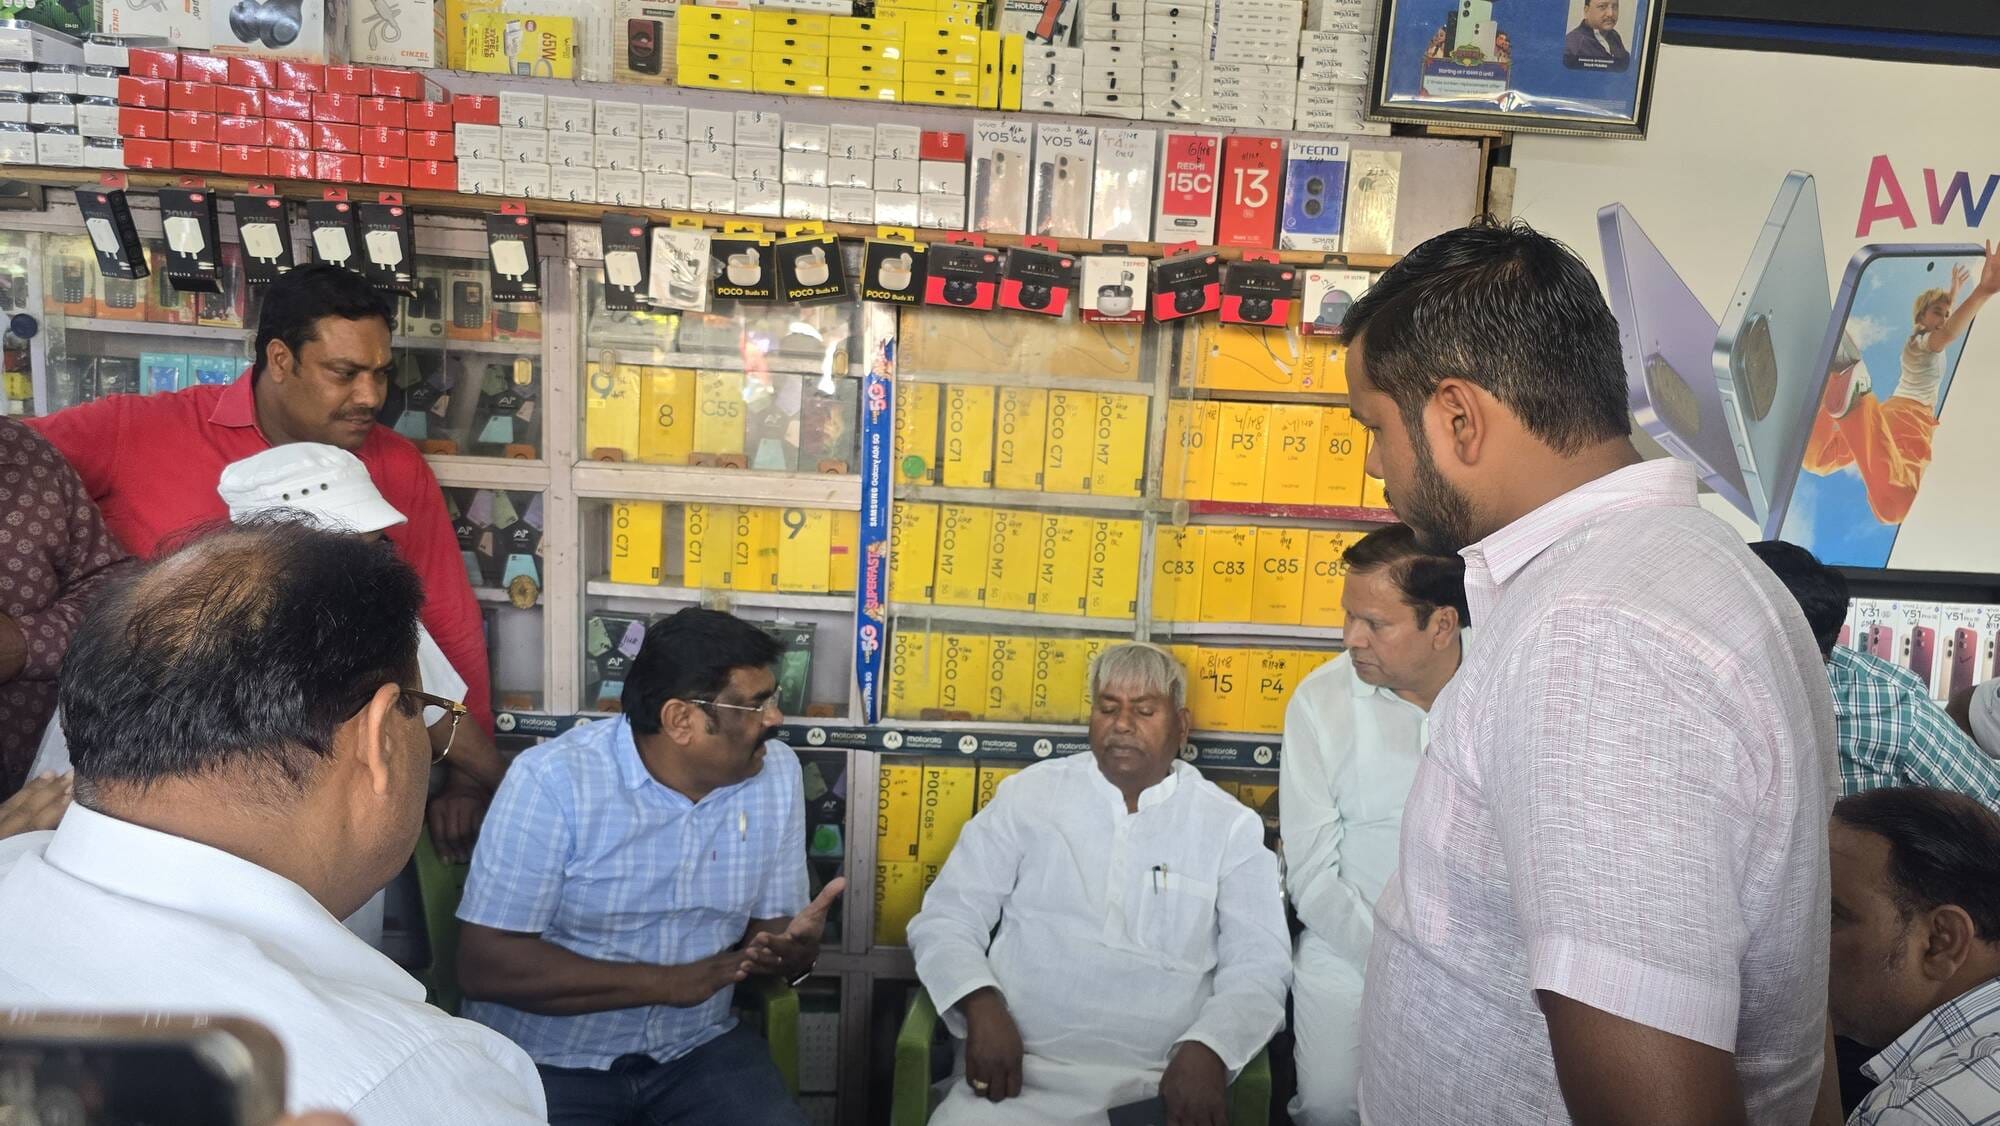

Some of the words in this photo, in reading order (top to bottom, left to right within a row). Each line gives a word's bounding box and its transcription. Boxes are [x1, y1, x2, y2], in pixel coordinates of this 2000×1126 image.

[1014, 3, 1045, 11] HOLDER
[400, 50, 430, 58] CINZEL
[542, 32, 557, 61] 65W
[1300, 144, 1338, 156] TECNO
[1177, 161, 1205, 170] REDMI
[1168, 173, 1212, 193] 15C
[1233, 168, 1269, 209] 13
[1855, 154, 2000, 238] Aw
[718, 287, 743, 296] POCO
[789, 289, 814, 298] POCO
[866, 290, 891, 300] POCO
[868, 383, 887, 411] 5G
[658, 404, 674, 427] 8
[701, 400, 739, 418] C55
[950, 388, 964, 432] POCO
[1003, 390, 1017, 435] POCO
[1052, 395, 1066, 440] POCO
[1099, 396, 1112, 440] POCO
[949, 438, 962, 463] C71
[1001, 439, 1014, 465] C71
[1231, 433, 1254, 450] P3
[1283, 436, 1306, 452] P3
[1329, 438, 1352, 455] 80
[1050, 444, 1063, 469] C71
[1097, 444, 1109, 465] M7
[871, 459, 881, 486] Galaxy
[869, 488, 878, 527] SAMSUNG
[689, 503, 702, 536] OCO
[736, 505, 749, 537] OCO
[783, 507, 807, 540] 9
[890, 505, 904, 547] POCO
[943, 508, 958, 550] POCO
[992, 512, 1007, 554] POCO
[1043, 518, 1058, 560] POCO
[1094, 521, 1108, 564] POCO
[616, 533, 628, 557] C71
[689, 540, 702, 563] C71
[736, 542, 748, 565] C71
[889, 551, 900, 572] M7
[941, 555, 954, 575] M7
[991, 558, 1004, 579] M7
[1162, 560, 1194, 575] C83
[1213, 561, 1245, 575] C83
[1264, 558, 1298, 574] C85
[1314, 561, 1349, 577] C85
[866, 552, 880, 609] SUPERFAST
[1041, 564, 1054, 584] M7
[1091, 567, 1104, 588] M7
[1860, 608, 1880, 617] Y31
[1903, 609, 1921, 618] Y51
[1945, 612, 1964, 621] Y51
[860, 625, 879, 651] 5G
[894, 634, 908, 676] POCO
[946, 638, 959, 680] POCO
[991, 639, 1006, 682] POCO
[1036, 641, 1050, 680] POCO
[943, 684, 956, 708] C71
[1035, 684, 1047, 708] C75
[1212, 675, 1232, 694] 15
[1261, 678, 1284, 694] P4
[990, 686, 1003, 709] C71
[520, 718, 557, 727] motorola
[830, 731, 867, 741] motorola
[907, 735, 942, 744] motorola
[982, 740, 1017, 748] motorola
[1202, 748, 1238, 756] motorola
[880, 768, 892, 810] POCO
[926, 770, 940, 807] POCO
[878, 815, 889, 837] C71
[924, 808, 934, 829] C85
